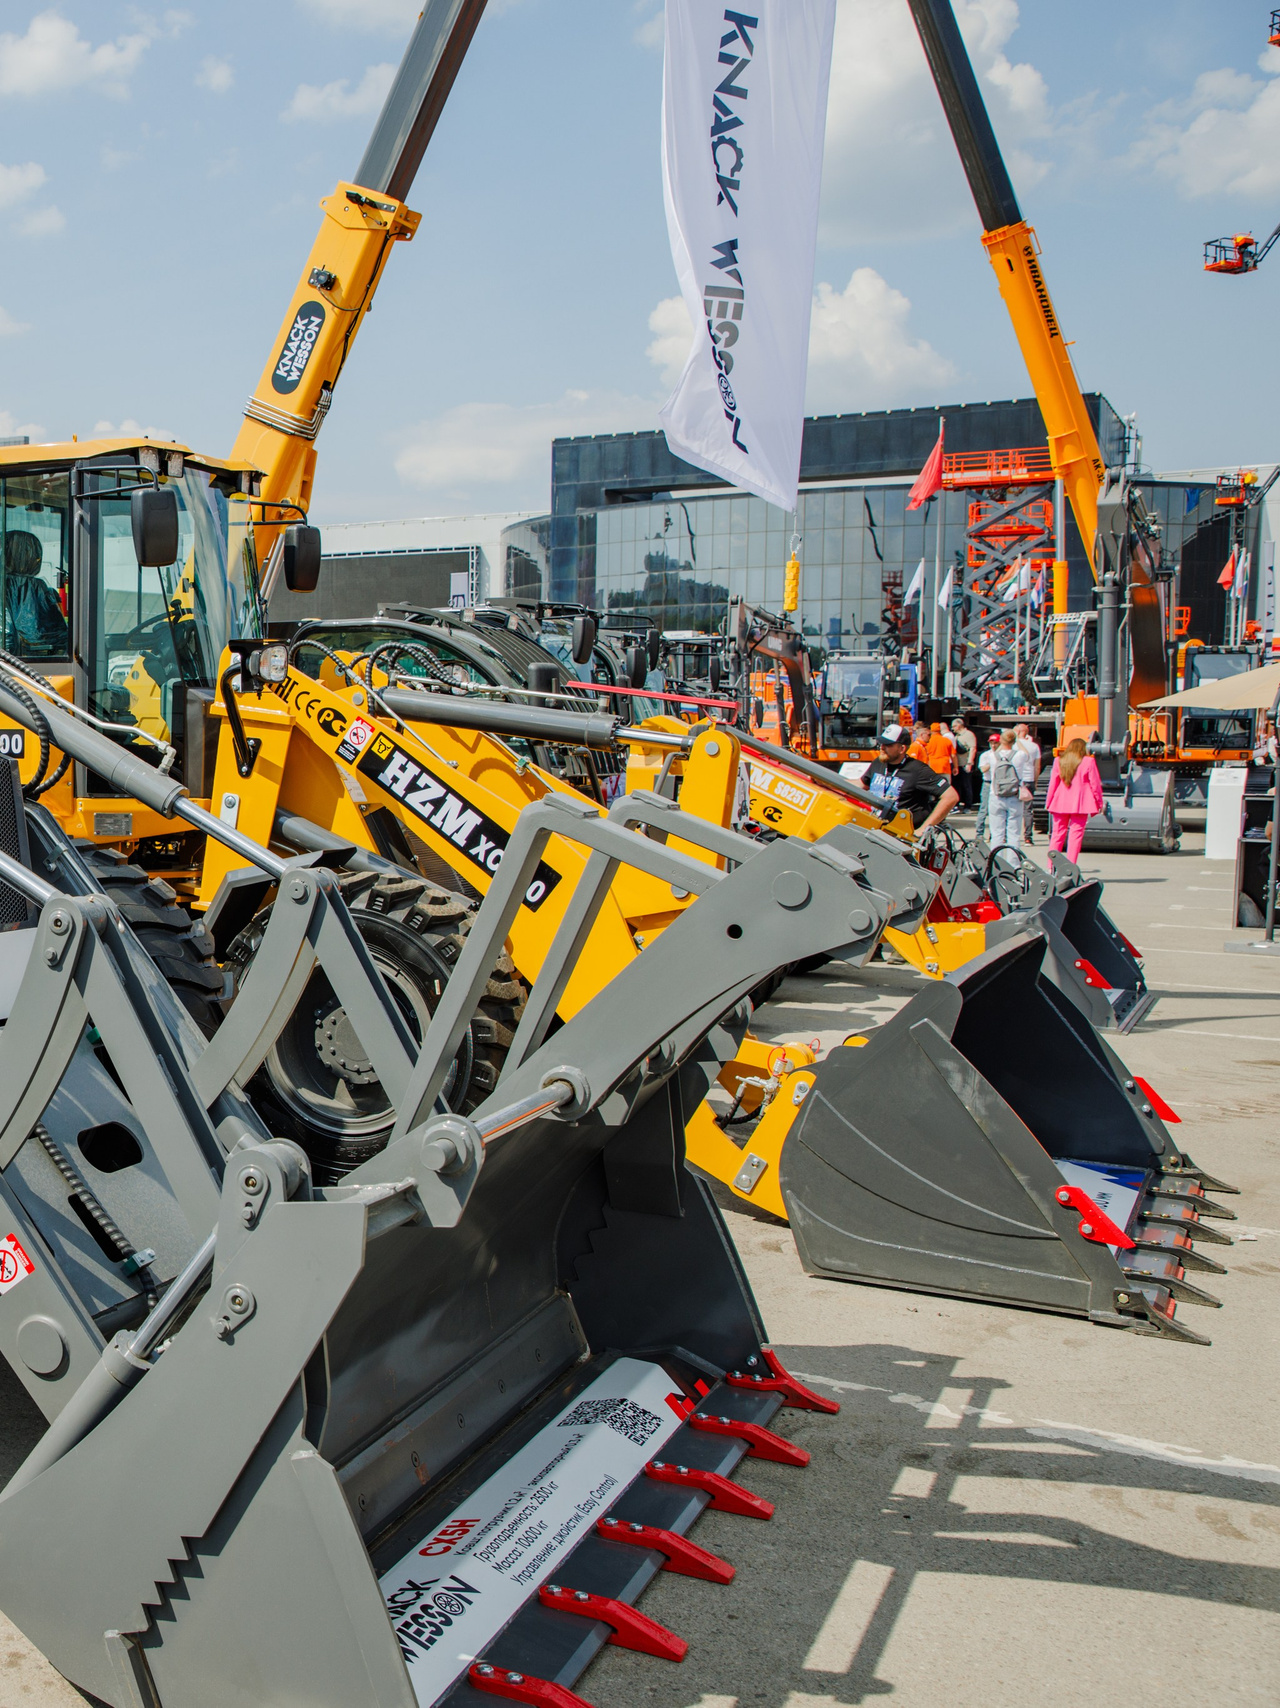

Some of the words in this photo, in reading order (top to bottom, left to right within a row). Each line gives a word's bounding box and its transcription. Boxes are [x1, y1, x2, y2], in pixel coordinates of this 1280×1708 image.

[711, 9, 759, 218] KNACK
[1027, 258, 1059, 338] ИВАНОВЕЦ
[276, 315, 309, 377] KNACK
[286, 316, 322, 381] WESSON
[377, 750, 483, 848] HZM
[774, 781, 810, 807] S825T
[472, 1503, 540, 1563] Грузоподъемность:
[529, 1486, 555, 1506] 2500
[548, 1480, 560, 1491] кг
[491, 1546, 526, 1575] Масса:
[514, 1524, 540, 1551] 10600
[536, 1519, 549, 1532] кг
[509, 1541, 559, 1586] Управление:
[552, 1512, 585, 1548] джойстик
[573, 1496, 601, 1516] (Easy
[588, 1473, 619, 1501] Control)
